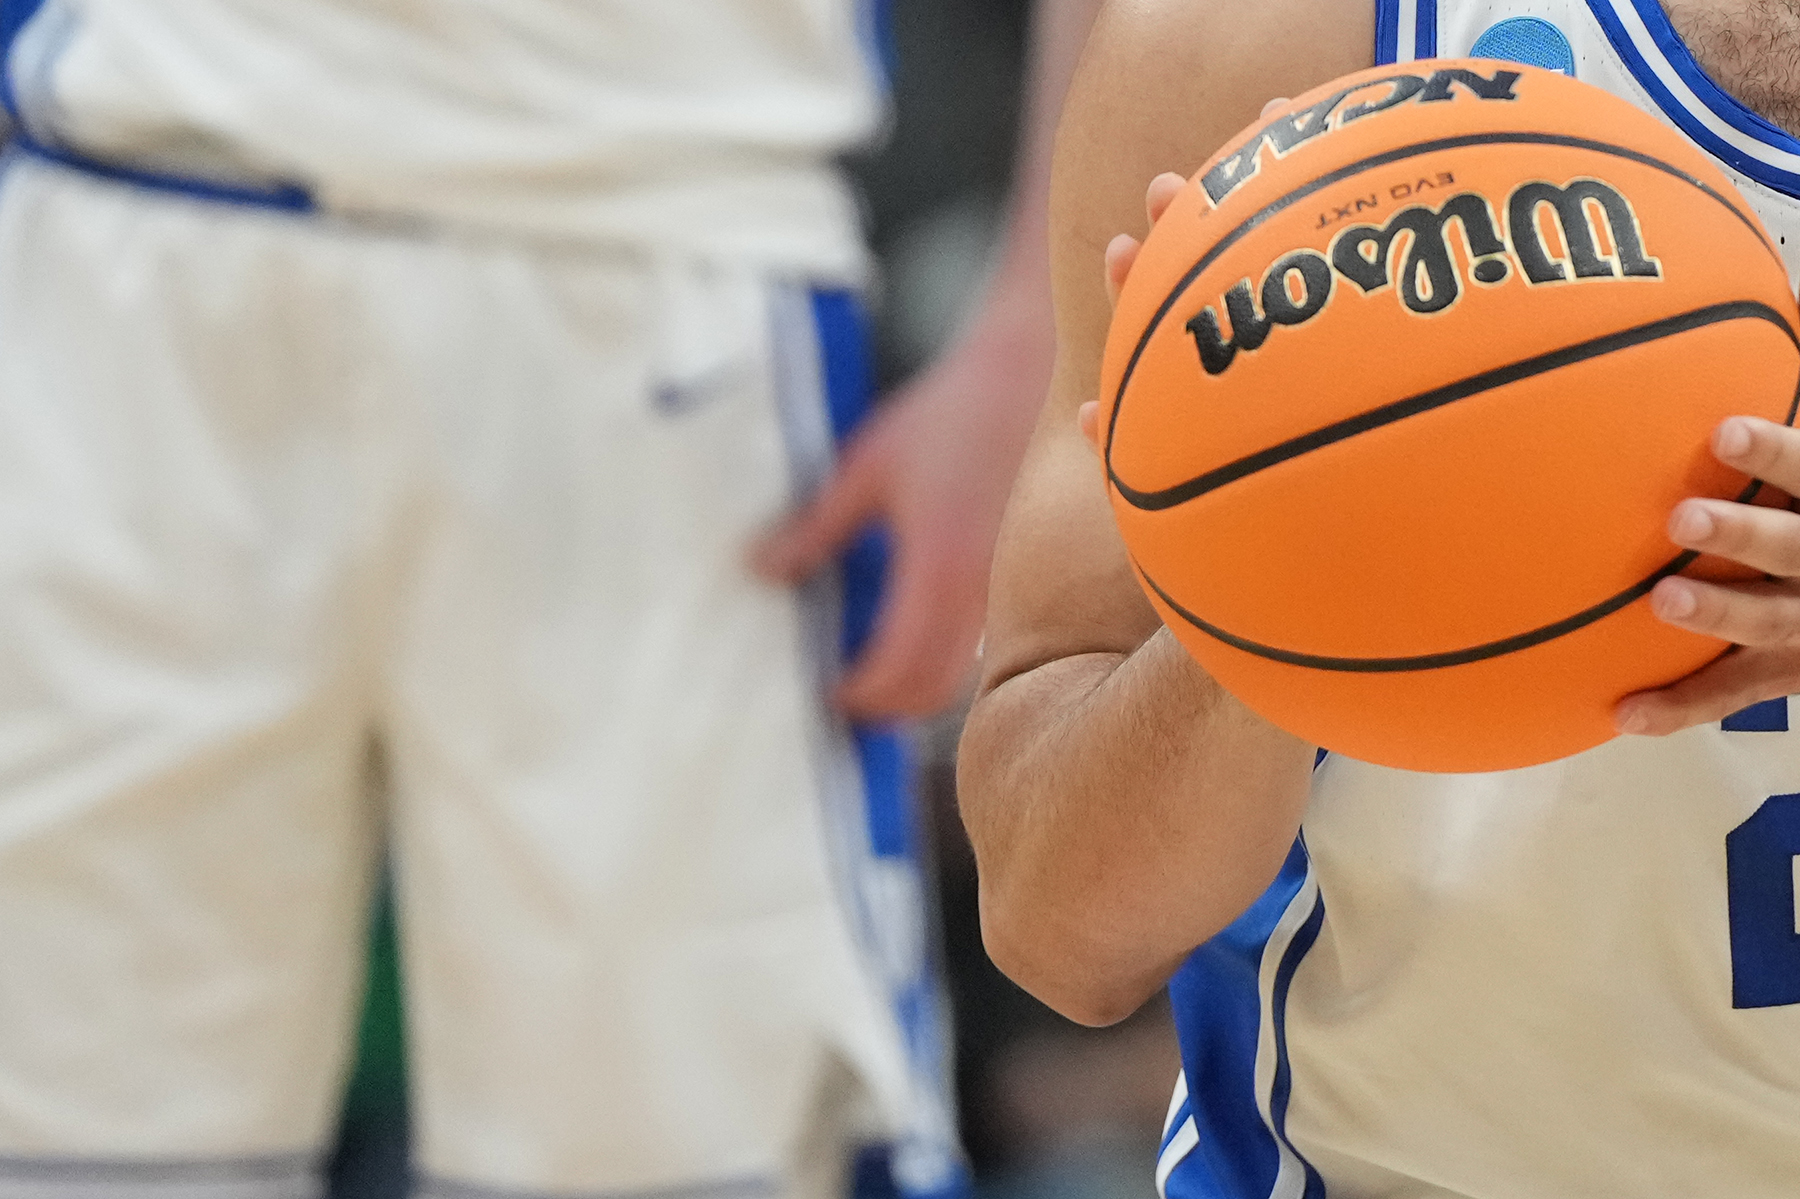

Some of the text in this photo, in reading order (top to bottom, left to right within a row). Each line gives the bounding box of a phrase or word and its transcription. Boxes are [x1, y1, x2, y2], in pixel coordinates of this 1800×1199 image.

[1200, 68, 1523, 210] NCAA
[1315, 171, 1456, 230] EVO NXT
[1185, 175, 1665, 377] Wilson
